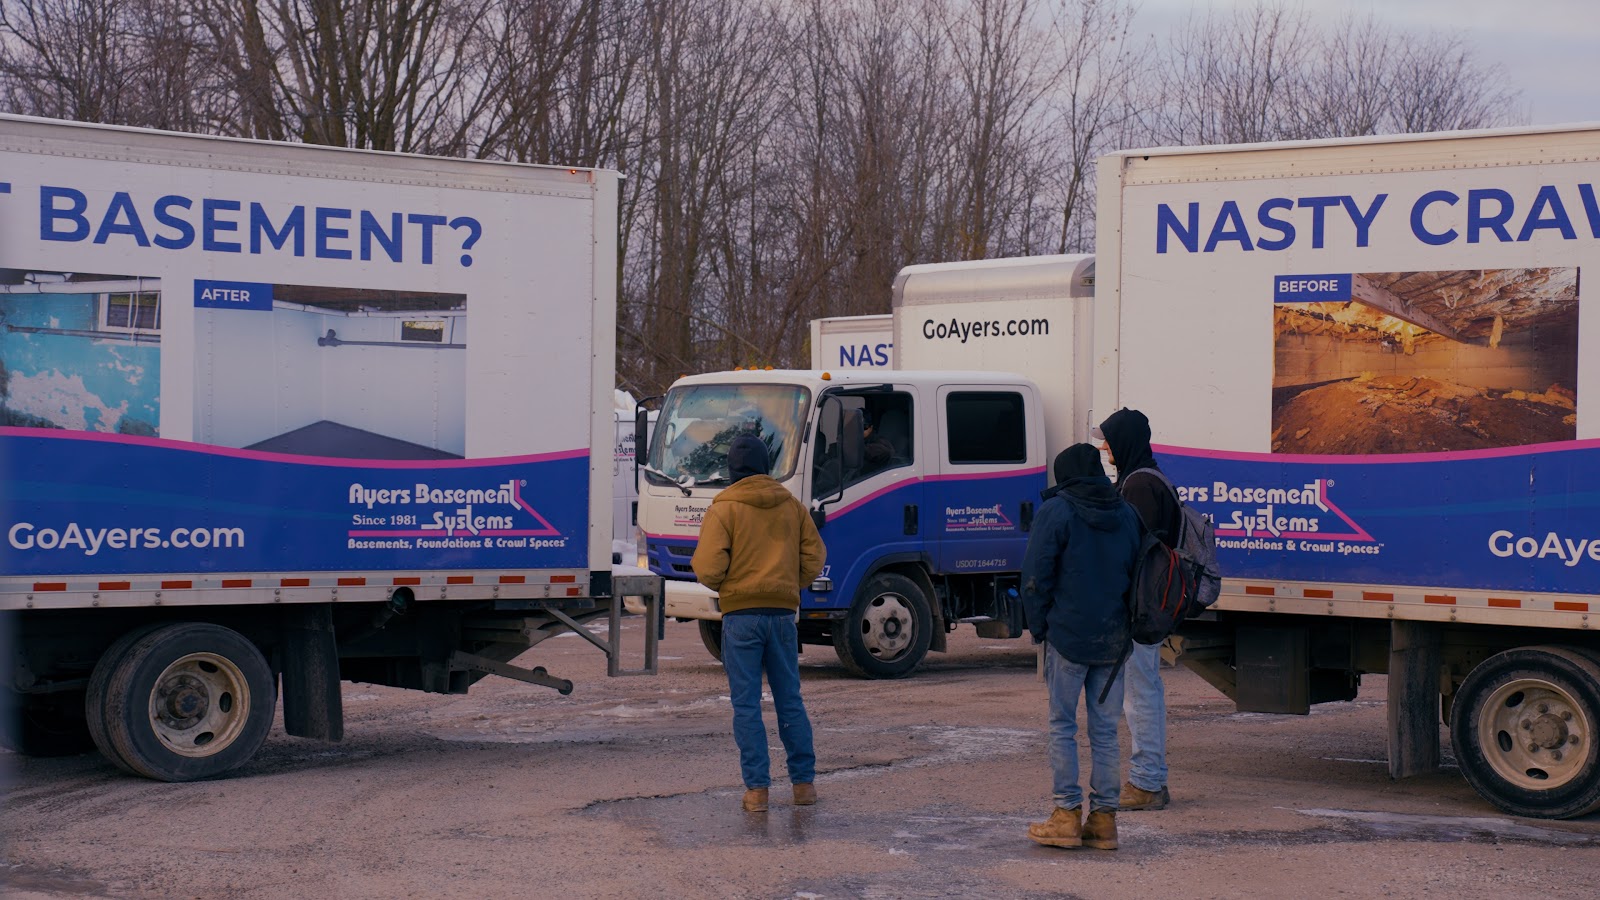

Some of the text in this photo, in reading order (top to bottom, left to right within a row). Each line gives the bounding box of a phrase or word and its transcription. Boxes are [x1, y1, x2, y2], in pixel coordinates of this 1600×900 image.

[40, 186, 482, 267] BASEMENT?
[1157, 194, 1388, 253] NASTY
[201, 288, 250, 302] AFTER
[1279, 279, 1338, 293] BEFORE
[923, 318, 1049, 343] GoAyers.com
[839, 343, 893, 367] NAS
[349, 483, 411, 509] Ayers
[1176, 485, 1208, 502] ers
[352, 514, 417, 525] Since 1981
[421, 504, 513, 536] Systems
[945, 504, 1000, 517] Ayers Basement
[968, 514, 998, 526] Systems
[1218, 504, 1318, 537] Systems
[8, 522, 245, 556] GoAyers.com
[348, 538, 413, 549] Basements,
[416, 537, 481, 549] Foundations
[484, 538, 493, 548] &
[496, 537, 527, 548] Crawl
[1215, 538, 1283, 551] Foundations
[1286, 540, 1296, 551] &
[1299, 540, 1334, 552] Crawl
